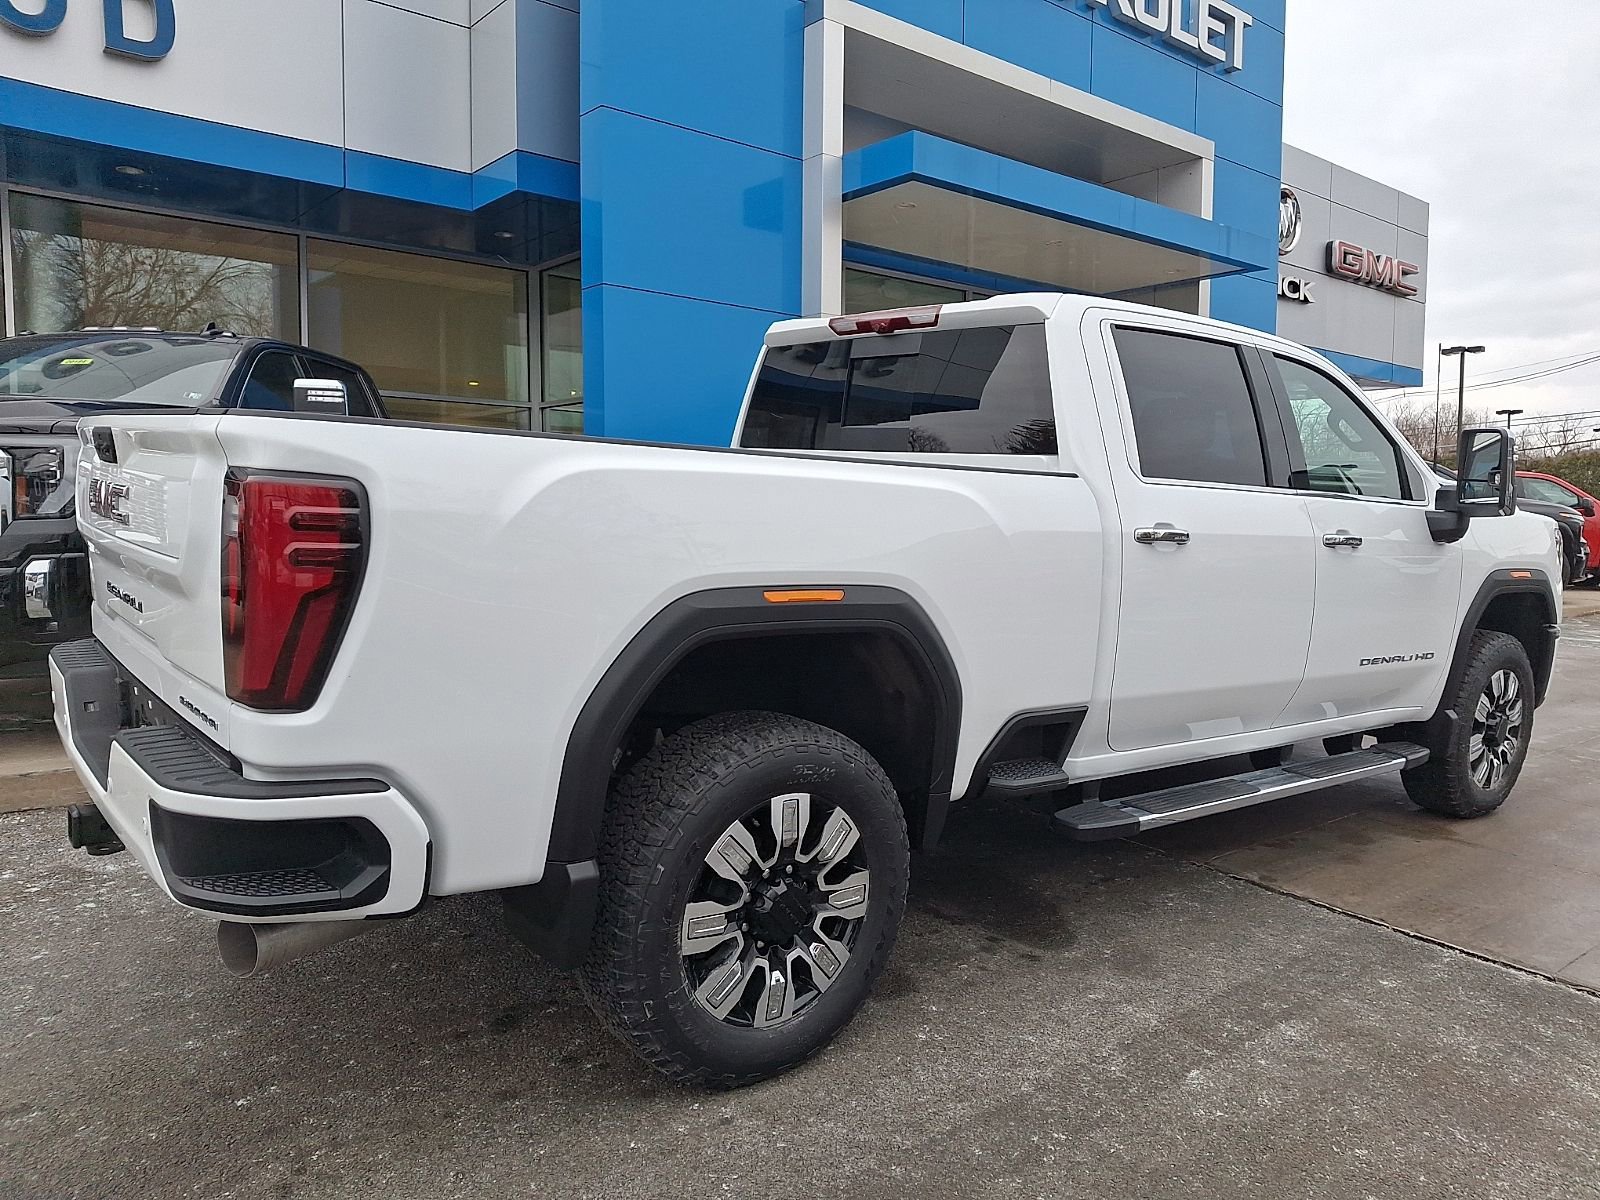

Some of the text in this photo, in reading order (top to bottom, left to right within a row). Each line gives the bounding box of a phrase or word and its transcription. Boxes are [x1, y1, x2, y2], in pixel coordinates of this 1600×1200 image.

[1092, 0, 1252, 72] OLET
[1328, 240, 1420, 296] GMC
[1359, 652, 1435, 667] DENALI HD
